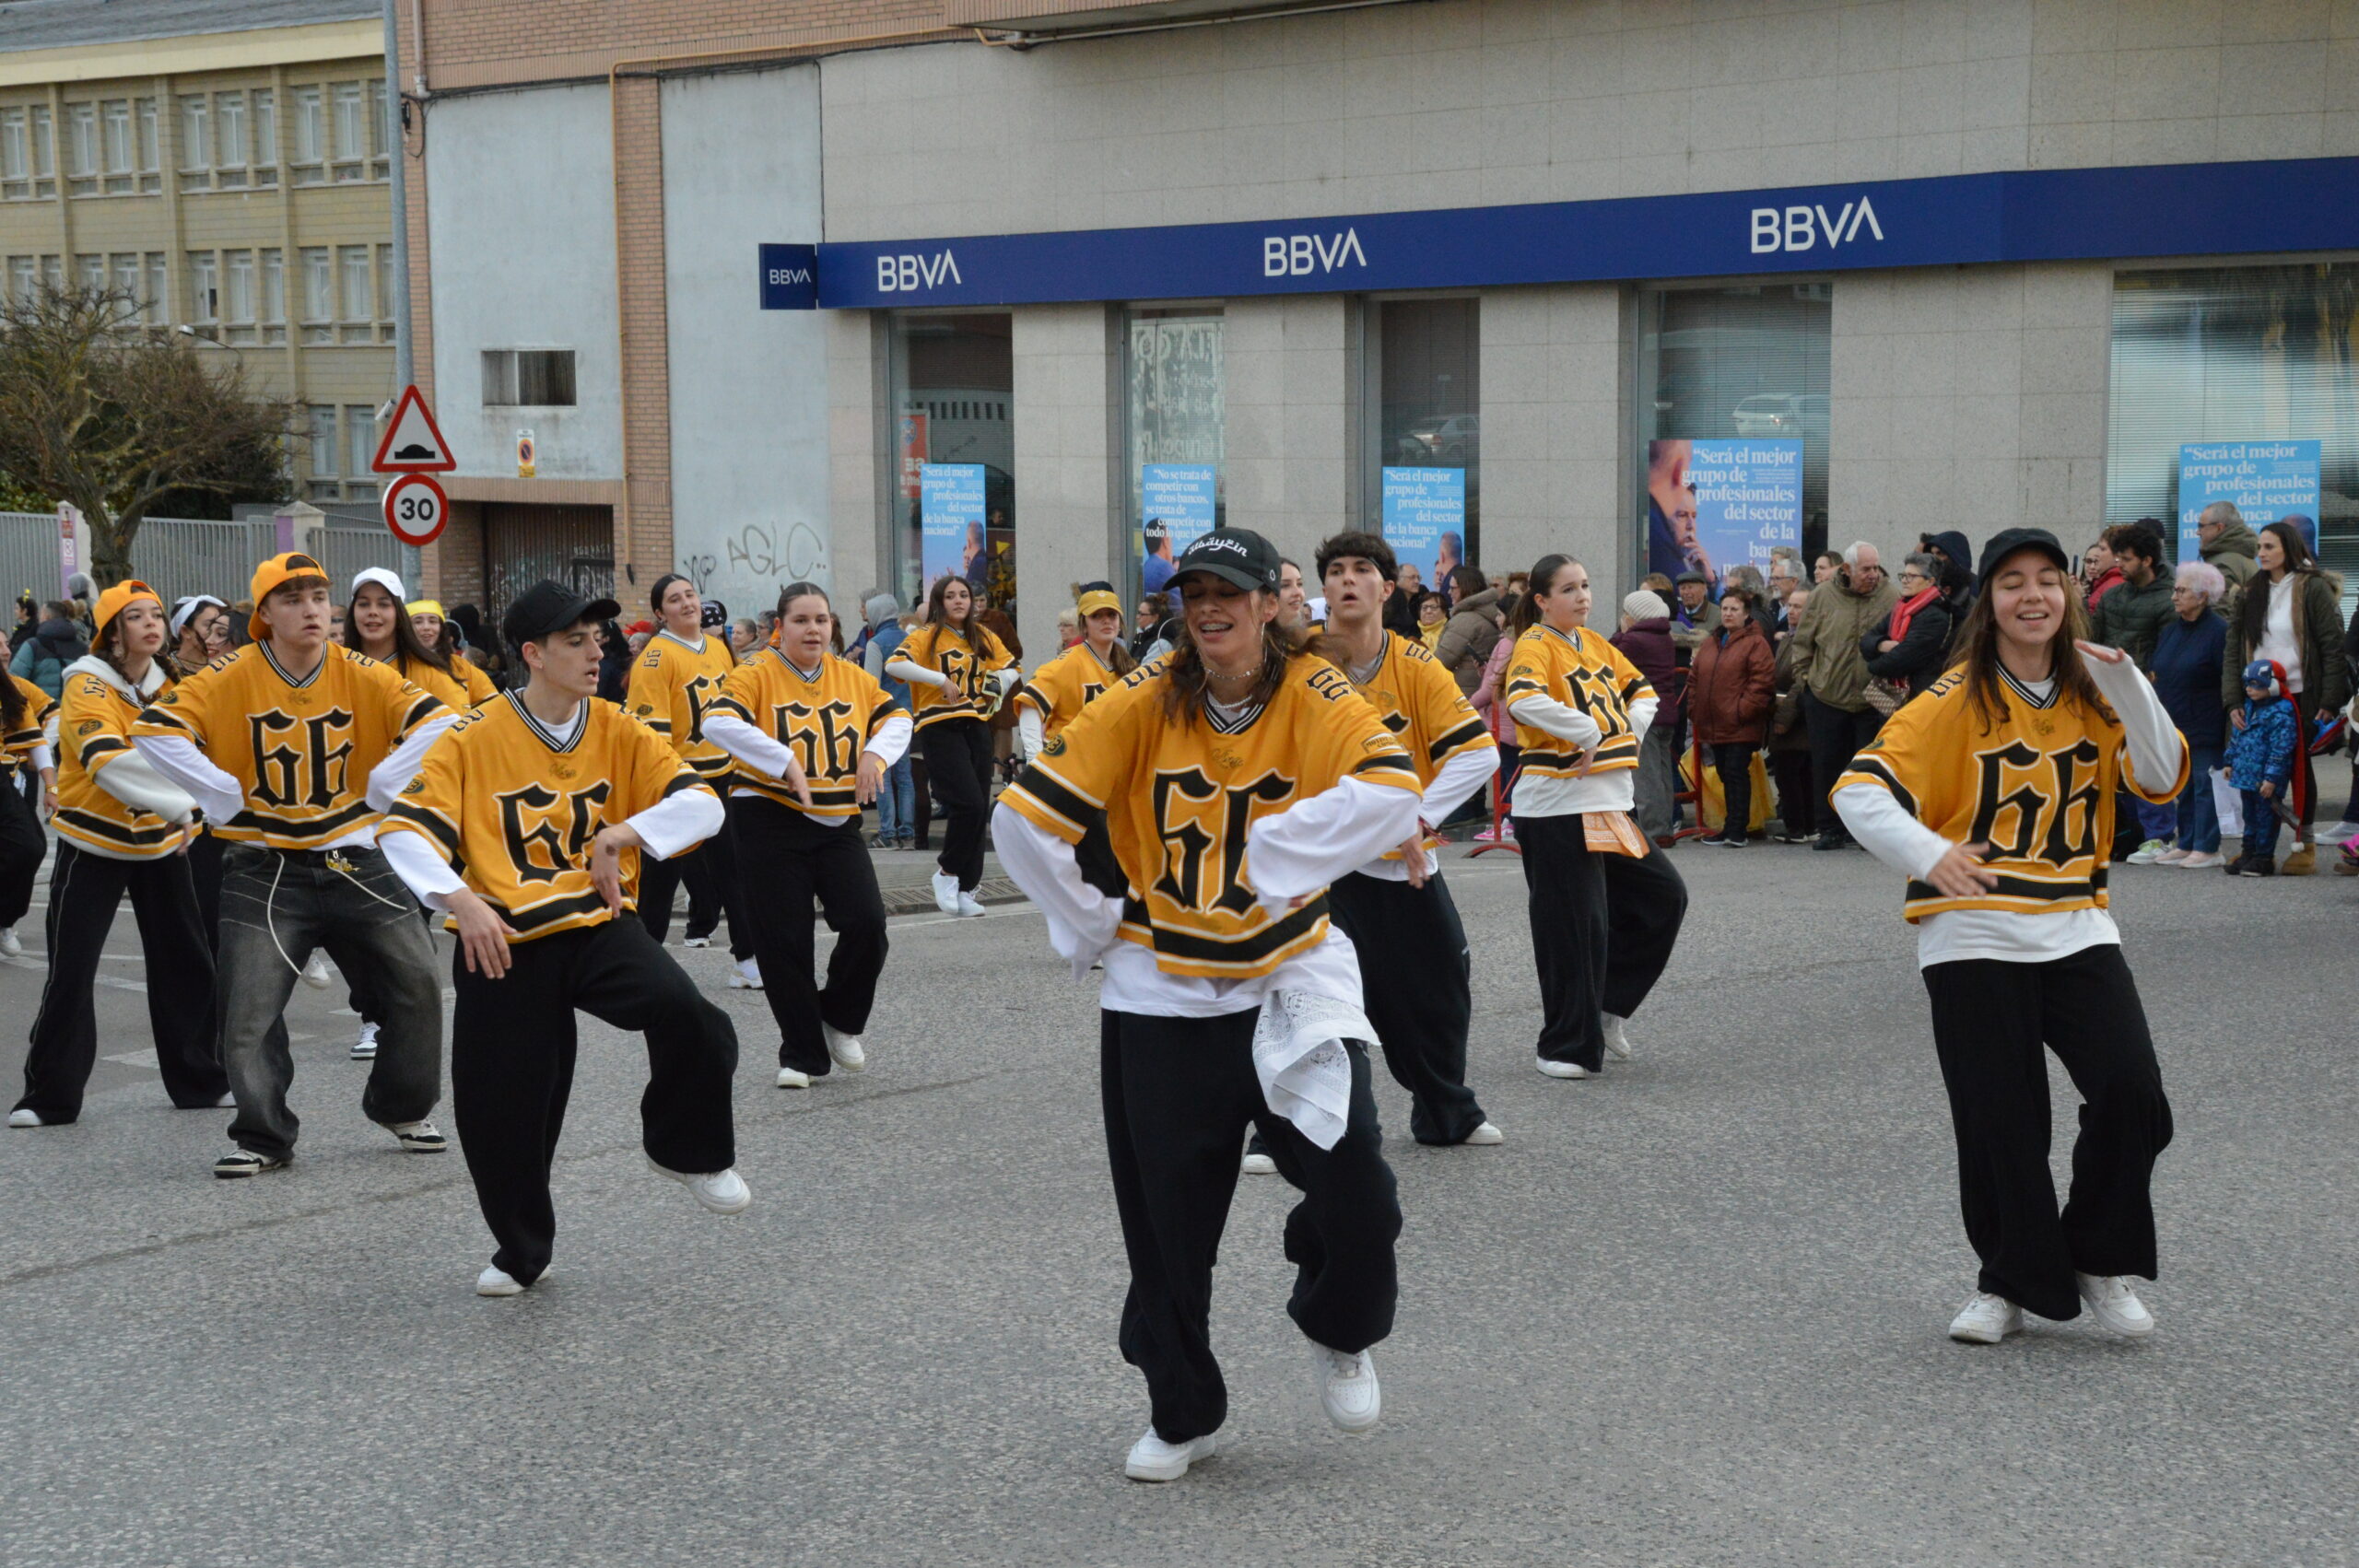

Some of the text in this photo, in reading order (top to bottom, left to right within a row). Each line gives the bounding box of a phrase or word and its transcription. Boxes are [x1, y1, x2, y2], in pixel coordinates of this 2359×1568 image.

[1751, 195, 1884, 254] BBVA
[1263, 227, 1367, 277] BBVA
[769, 267, 812, 285] BBVA
[877, 248, 962, 292] BBVA
[1693, 447, 1797, 467] “Será el mejor
[2230, 445, 2246, 459] el
[2248, 443, 2298, 461] mejor
[944, 465, 951, 477] el
[952, 465, 974, 478] mejor
[1169, 471, 1180, 479] se
[1180, 470, 1200, 480] trata
[1200, 469, 1212, 480] de
[1412, 469, 1421, 482] el
[1422, 470, 1451, 484] mejor
[1681, 470, 1728, 487] grupo
[1729, 466, 1748, 483] de
[2183, 464, 2234, 480] grupo
[2236, 461, 2257, 474] de
[922, 479, 945, 492] grupo
[946, 477, 957, 489] de
[1145, 481, 1199, 493] competir con
[1385, 485, 1414, 497] grupo
[1415, 483, 1427, 495] de
[2205, 474, 2316, 495] profesionales
[933, 489, 983, 502] profesionales
[1155, 494, 1176, 503] otros
[1696, 484, 1796, 506] profesionales
[2236, 491, 2316, 506] del sector
[400, 497, 434, 521] 30
[947, 501, 983, 513] del sector
[1145, 505, 1187, 515] se trata de
[1397, 497, 1462, 511] profesionales
[924, 513, 965, 523] de la banca
[1415, 509, 1462, 522] del sector
[1723, 504, 1796, 521] del sector
[1157, 516, 1212, 529] competir con
[1385, 522, 1438, 535] de la banca
[1145, 527, 1165, 538] todo
[1175, 530, 1191, 541] que
[1759, 522, 1779, 540] de
[1780, 522, 1796, 540] la
[1306, 667, 1359, 703] 66
[772, 698, 861, 786] 66
[246, 705, 355, 810] 66
[1957, 736, 2100, 872] 66
